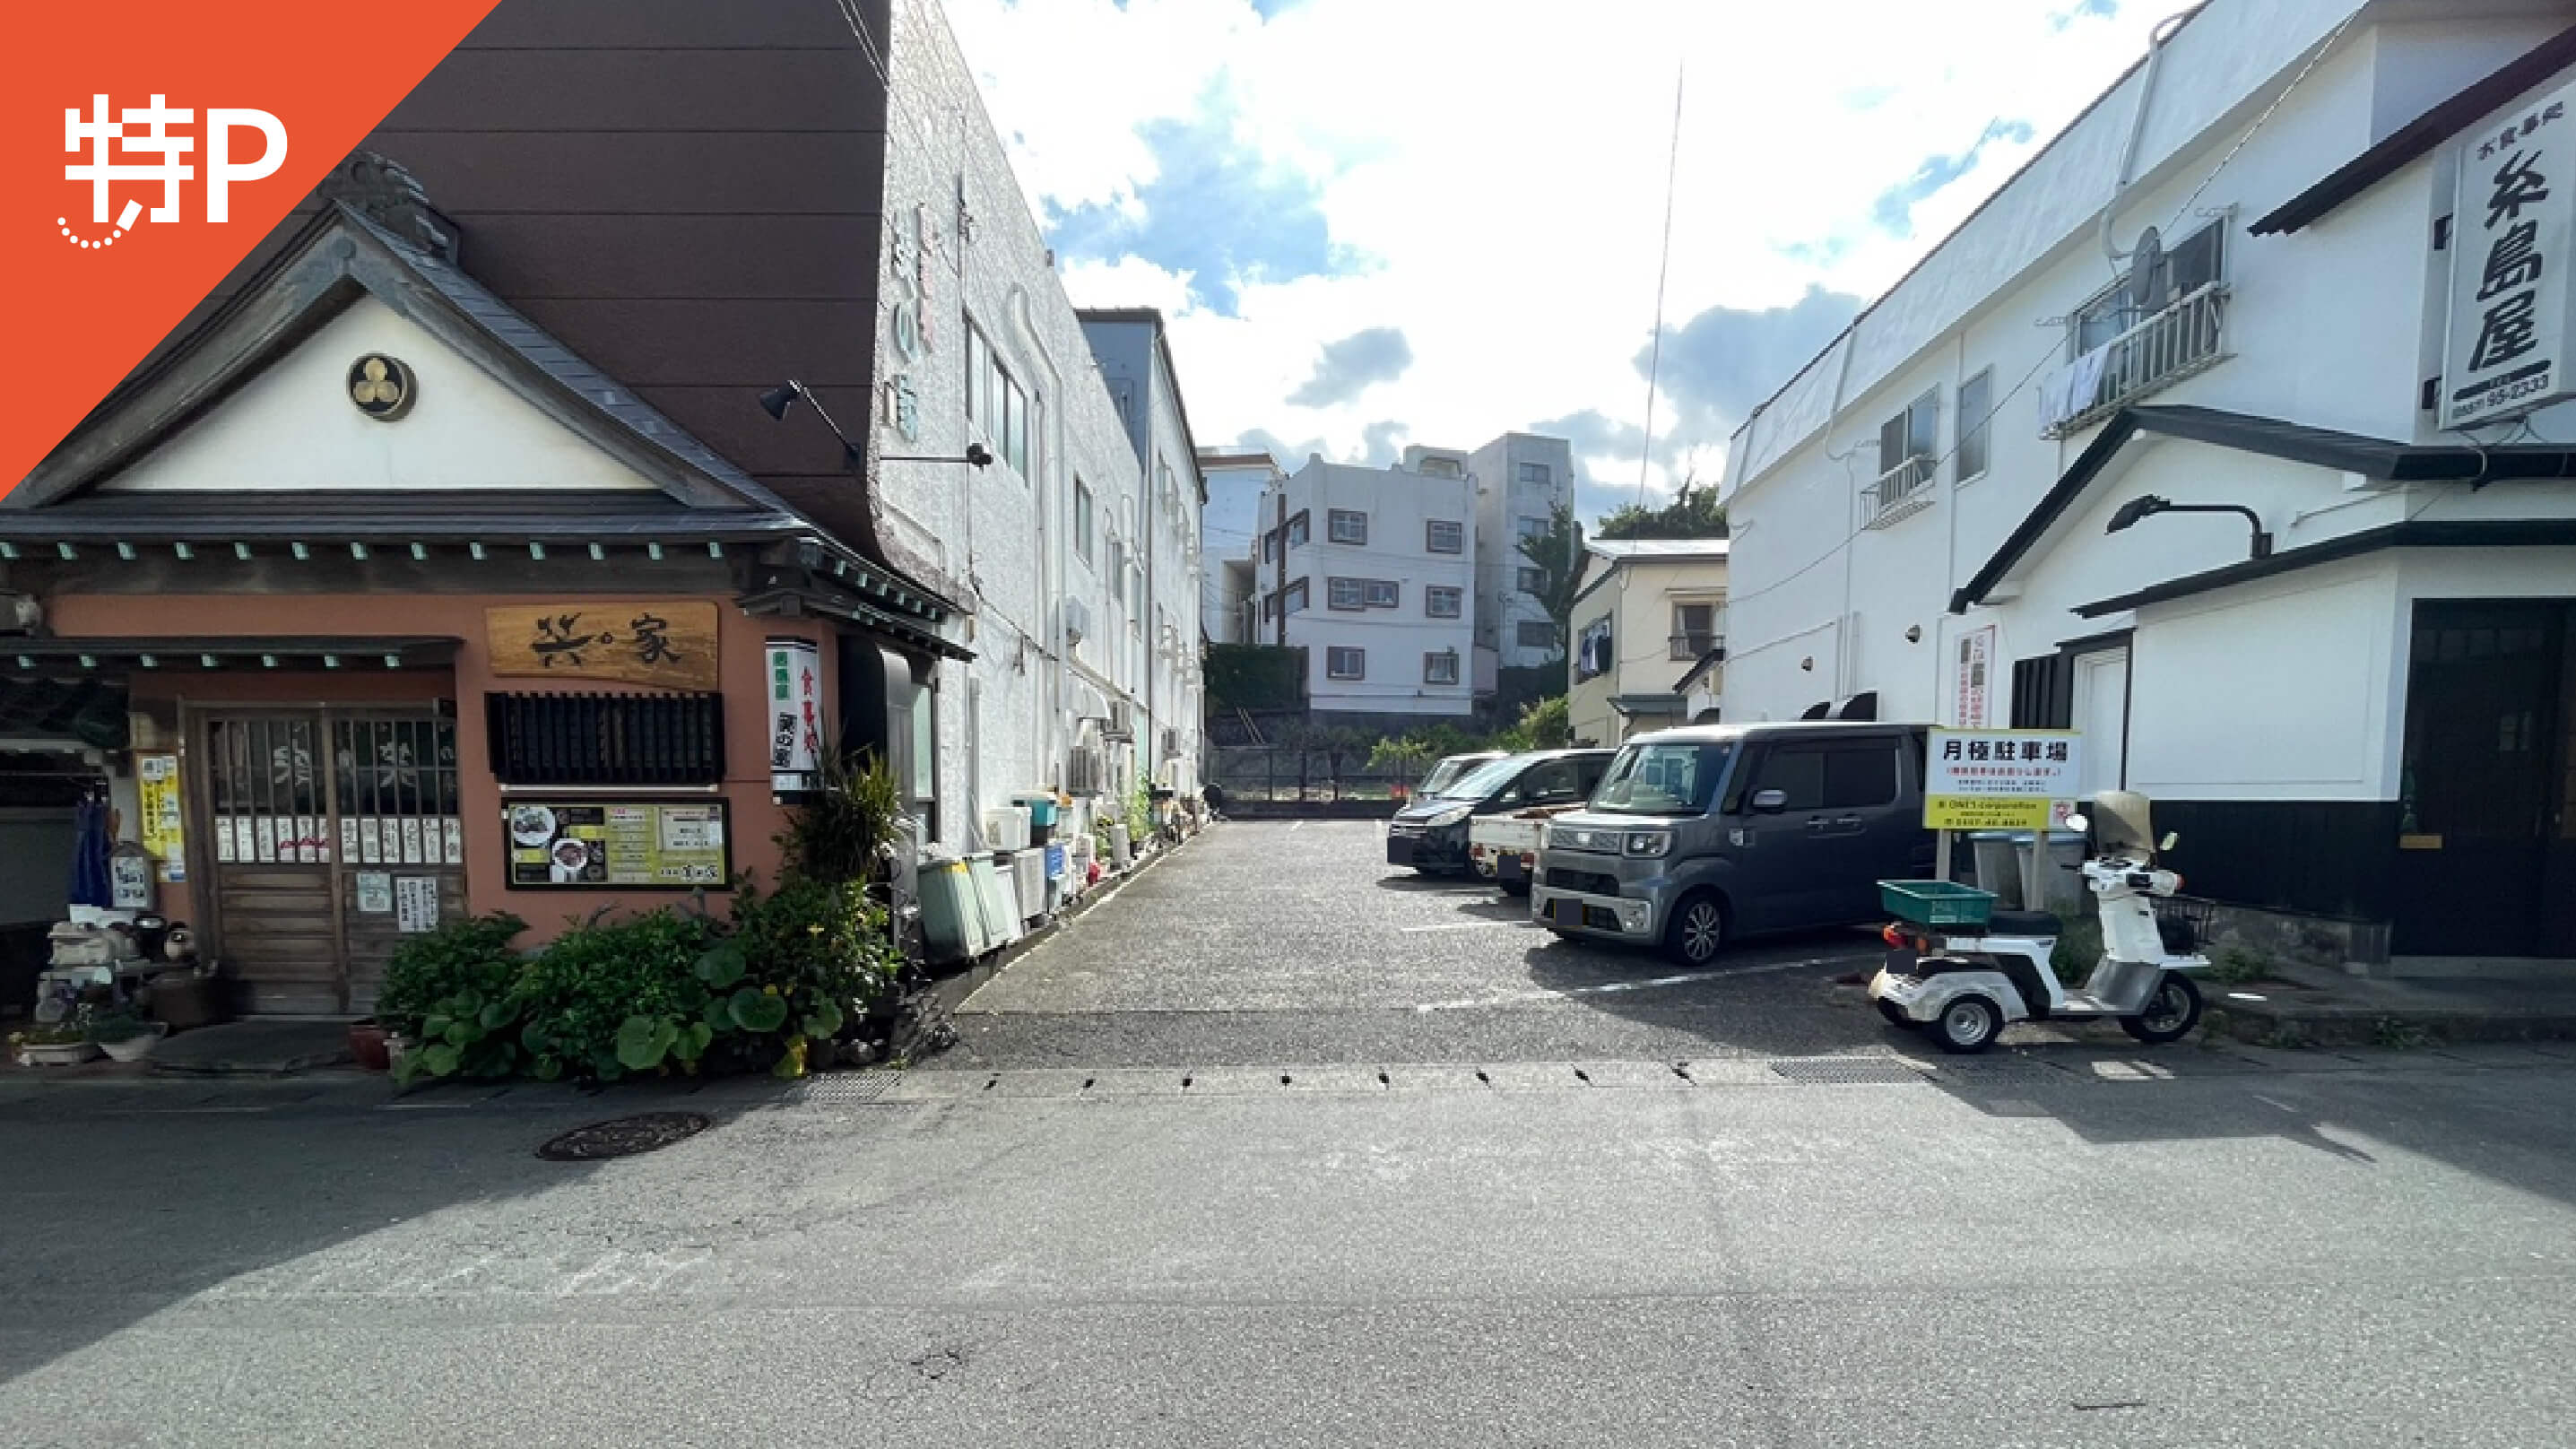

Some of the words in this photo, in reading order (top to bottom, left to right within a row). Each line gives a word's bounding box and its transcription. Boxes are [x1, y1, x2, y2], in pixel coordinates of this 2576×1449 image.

[2468, 149, 2551, 372] 糸島屋
[1943, 738, 2069, 763] 月極駐車場
